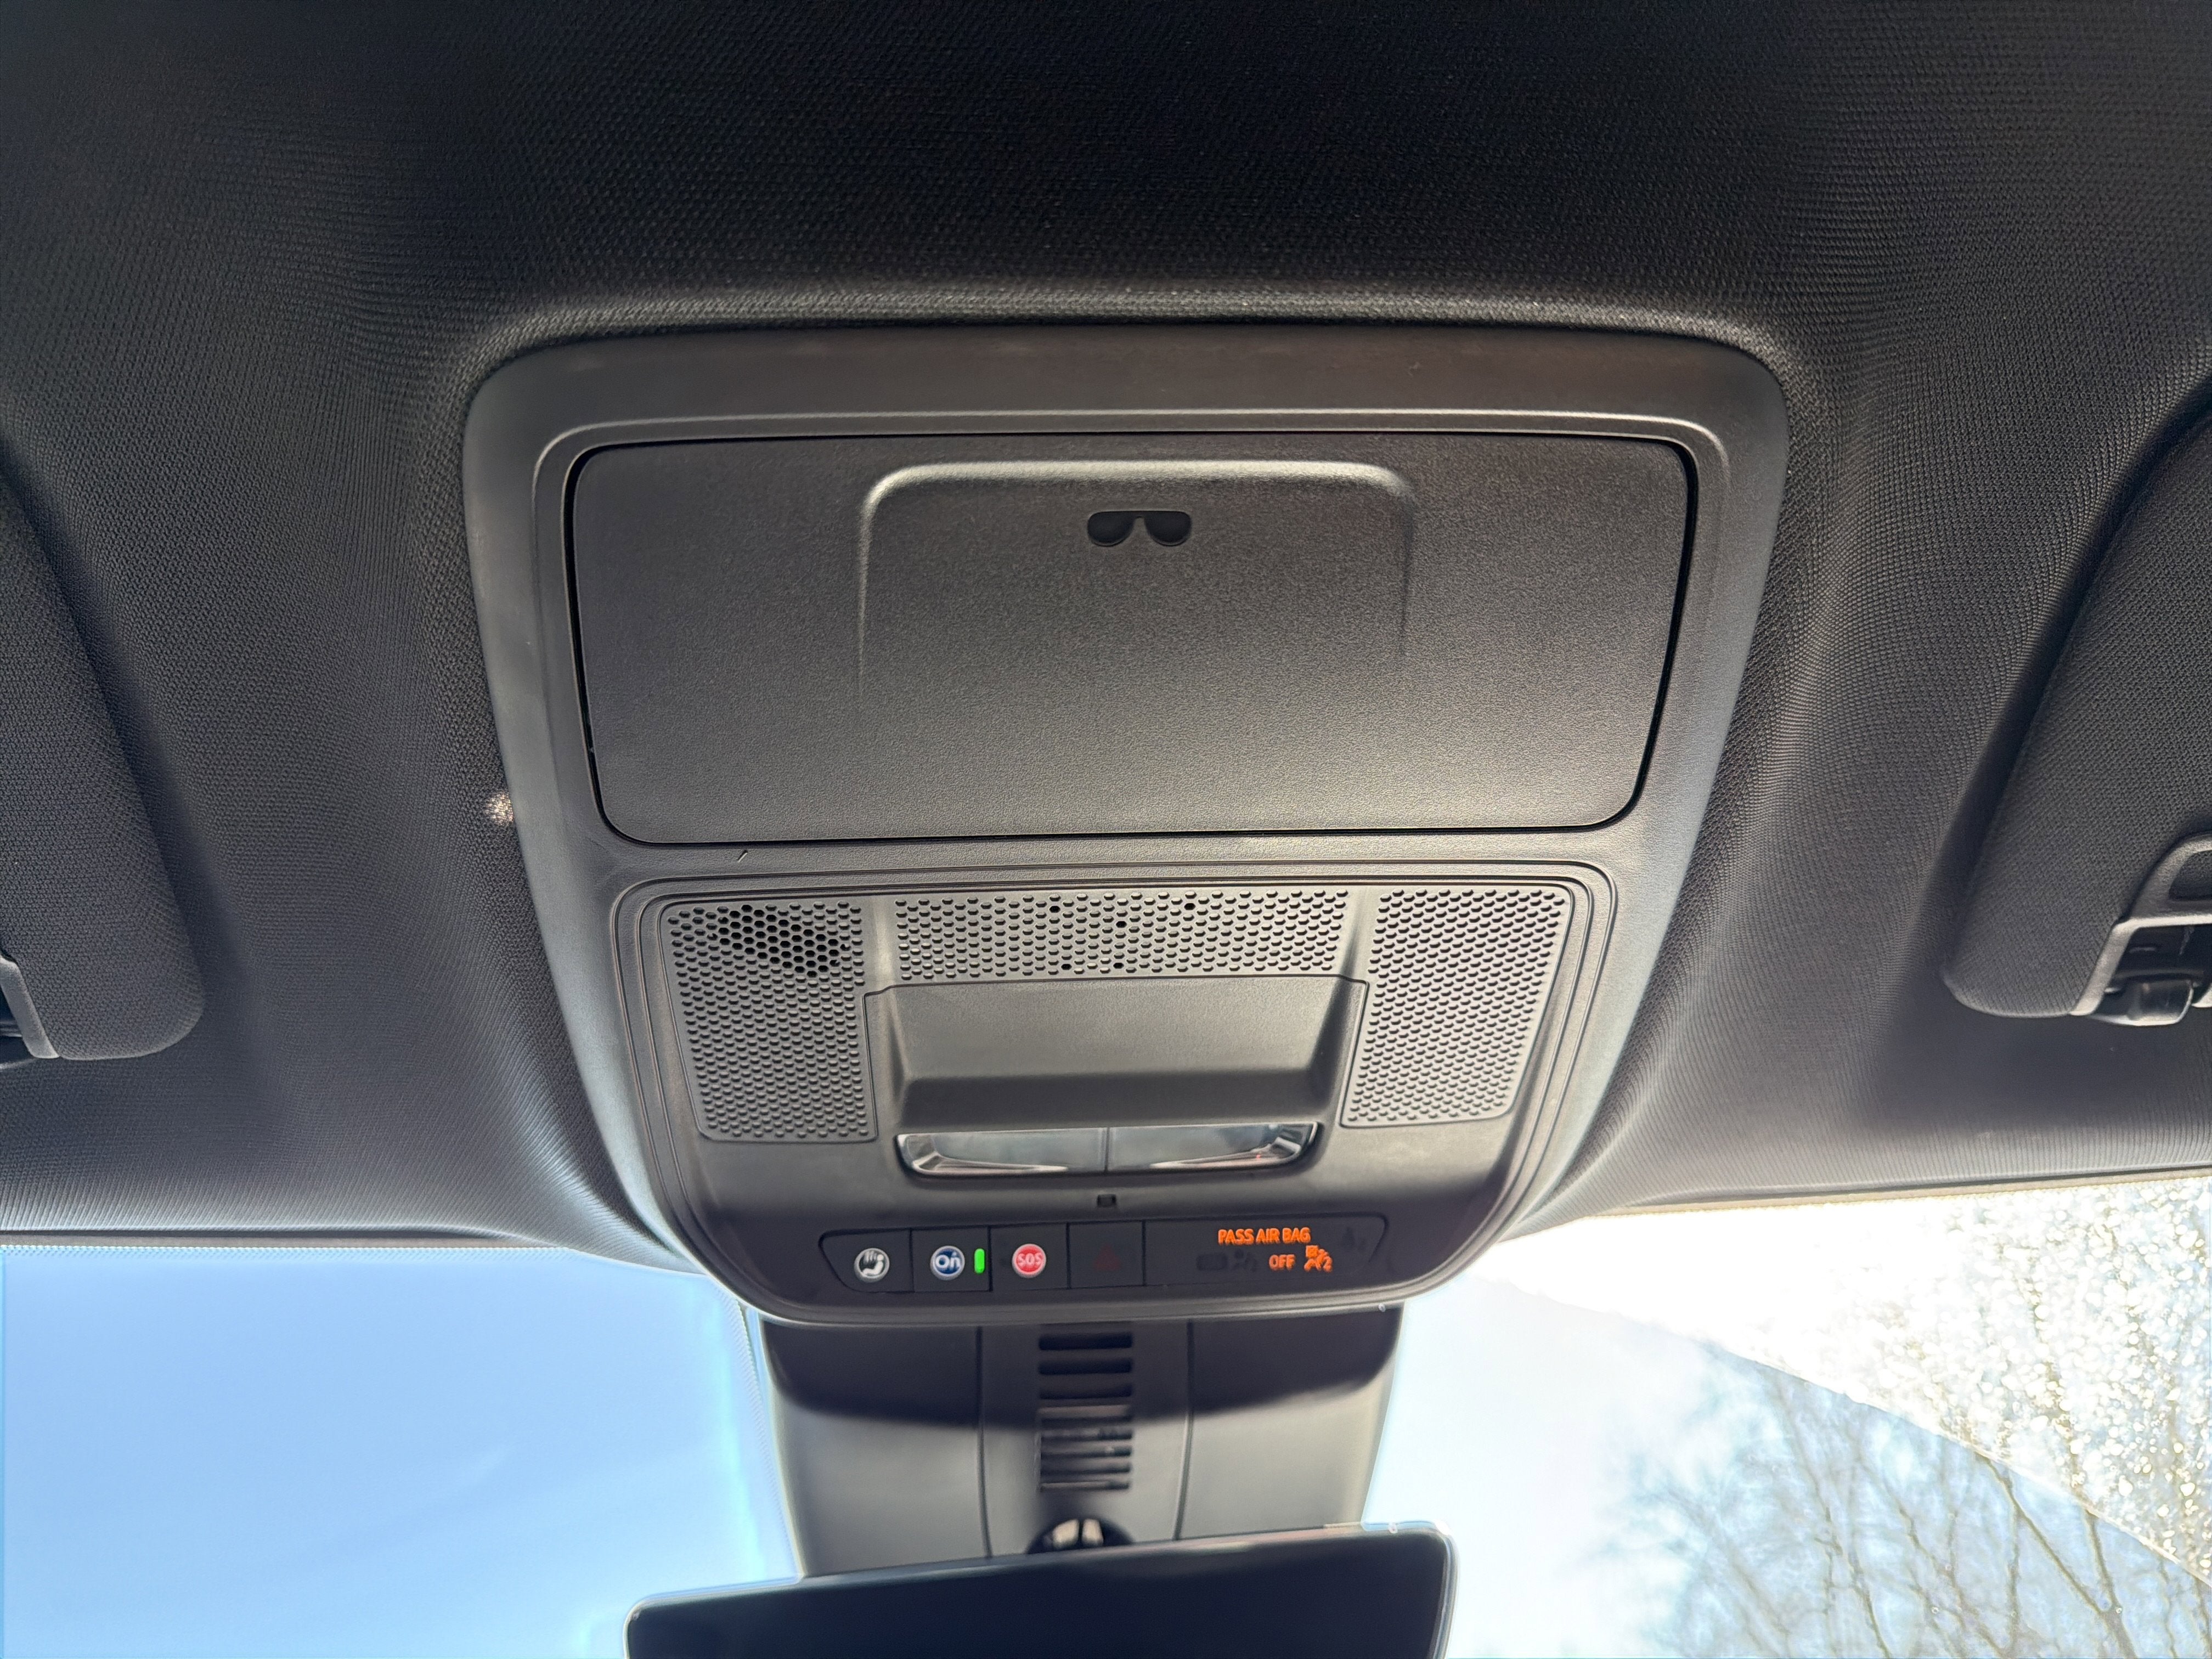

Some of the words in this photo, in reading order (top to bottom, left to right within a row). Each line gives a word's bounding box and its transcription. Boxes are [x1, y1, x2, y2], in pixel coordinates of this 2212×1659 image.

[1218, 1228, 1255, 1245] PASS
[1256, 1228, 1280, 1244] AIR
[1282, 1227, 1311, 1244] BAG
[1017, 1252, 1043, 1267] SOS
[1268, 1254, 1296, 1271] OFF
